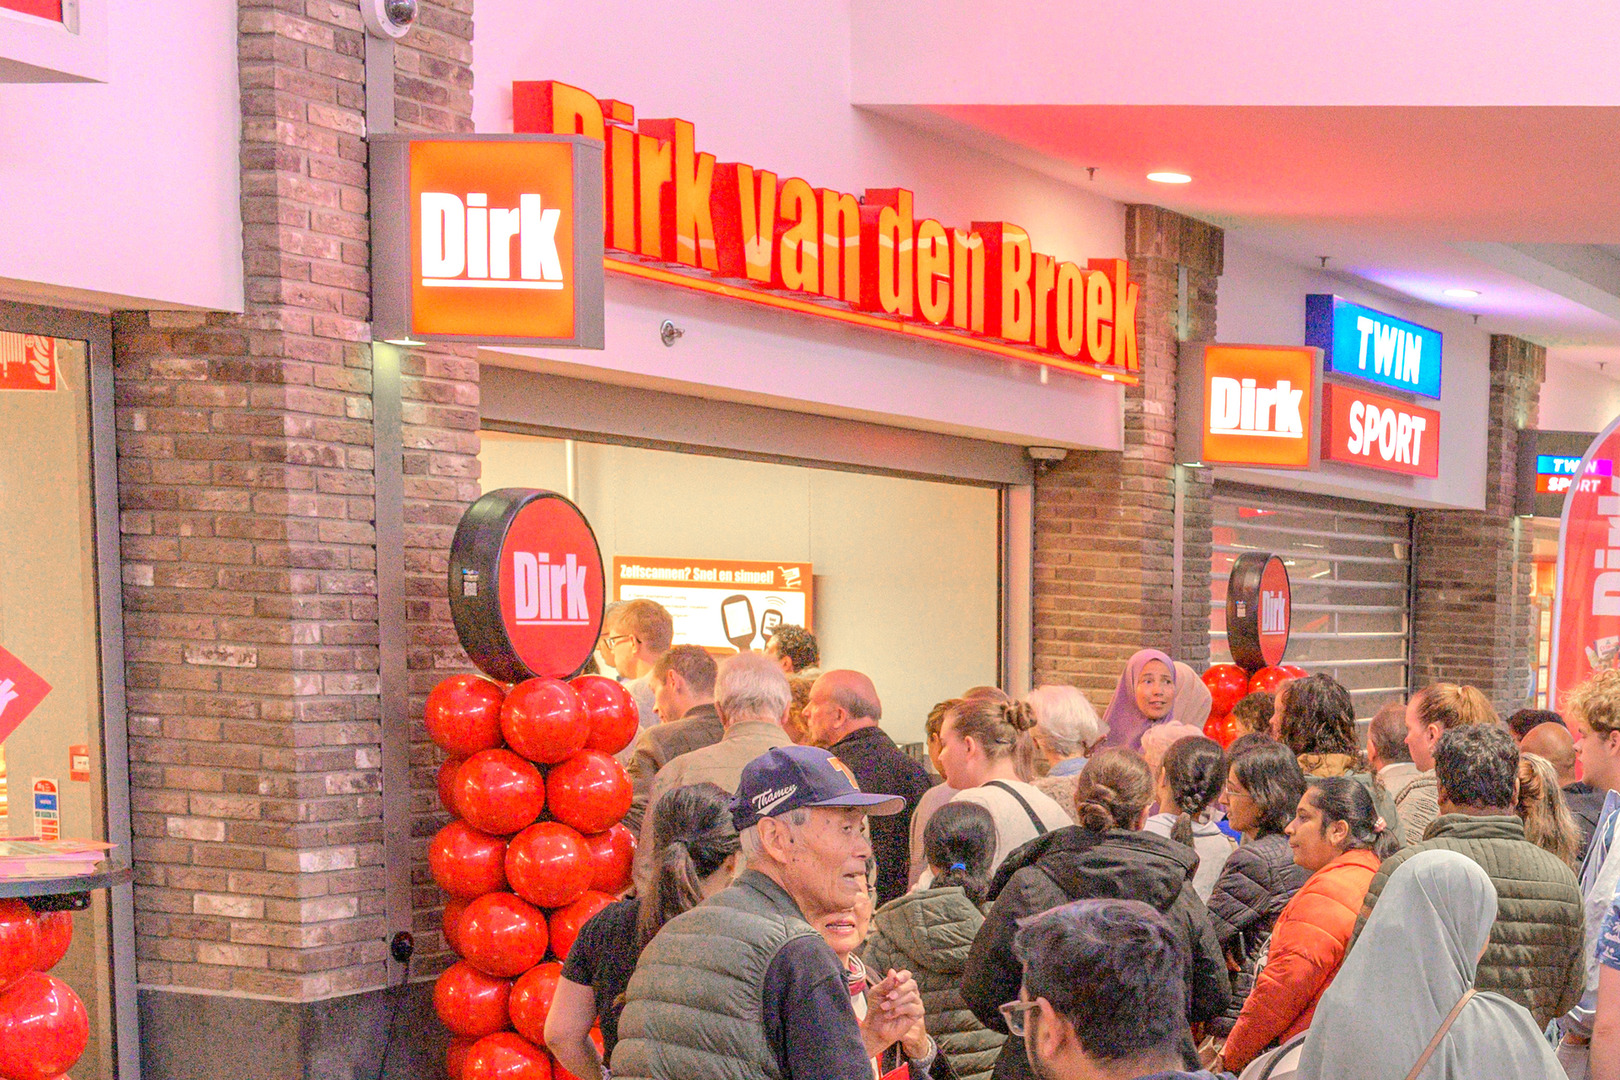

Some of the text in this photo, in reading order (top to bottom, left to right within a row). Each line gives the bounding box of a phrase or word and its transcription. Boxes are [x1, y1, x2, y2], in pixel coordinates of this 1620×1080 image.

[420, 191, 563, 282] Dirk
[737, 162, 862, 302] van
[877, 188, 986, 332] den
[1001, 221, 1139, 370] Broek
[1356, 316, 1422, 385] TWIN
[1209, 376, 1303, 433] Dirk
[1347, 400, 1426, 466] SPORT
[1553, 458, 1597, 474] TWN
[512, 551, 589, 621] Dirk
[620, 564, 774, 584] Zelfscannen? Snel en simpel!
[1261, 590, 1285, 632] Dirk
